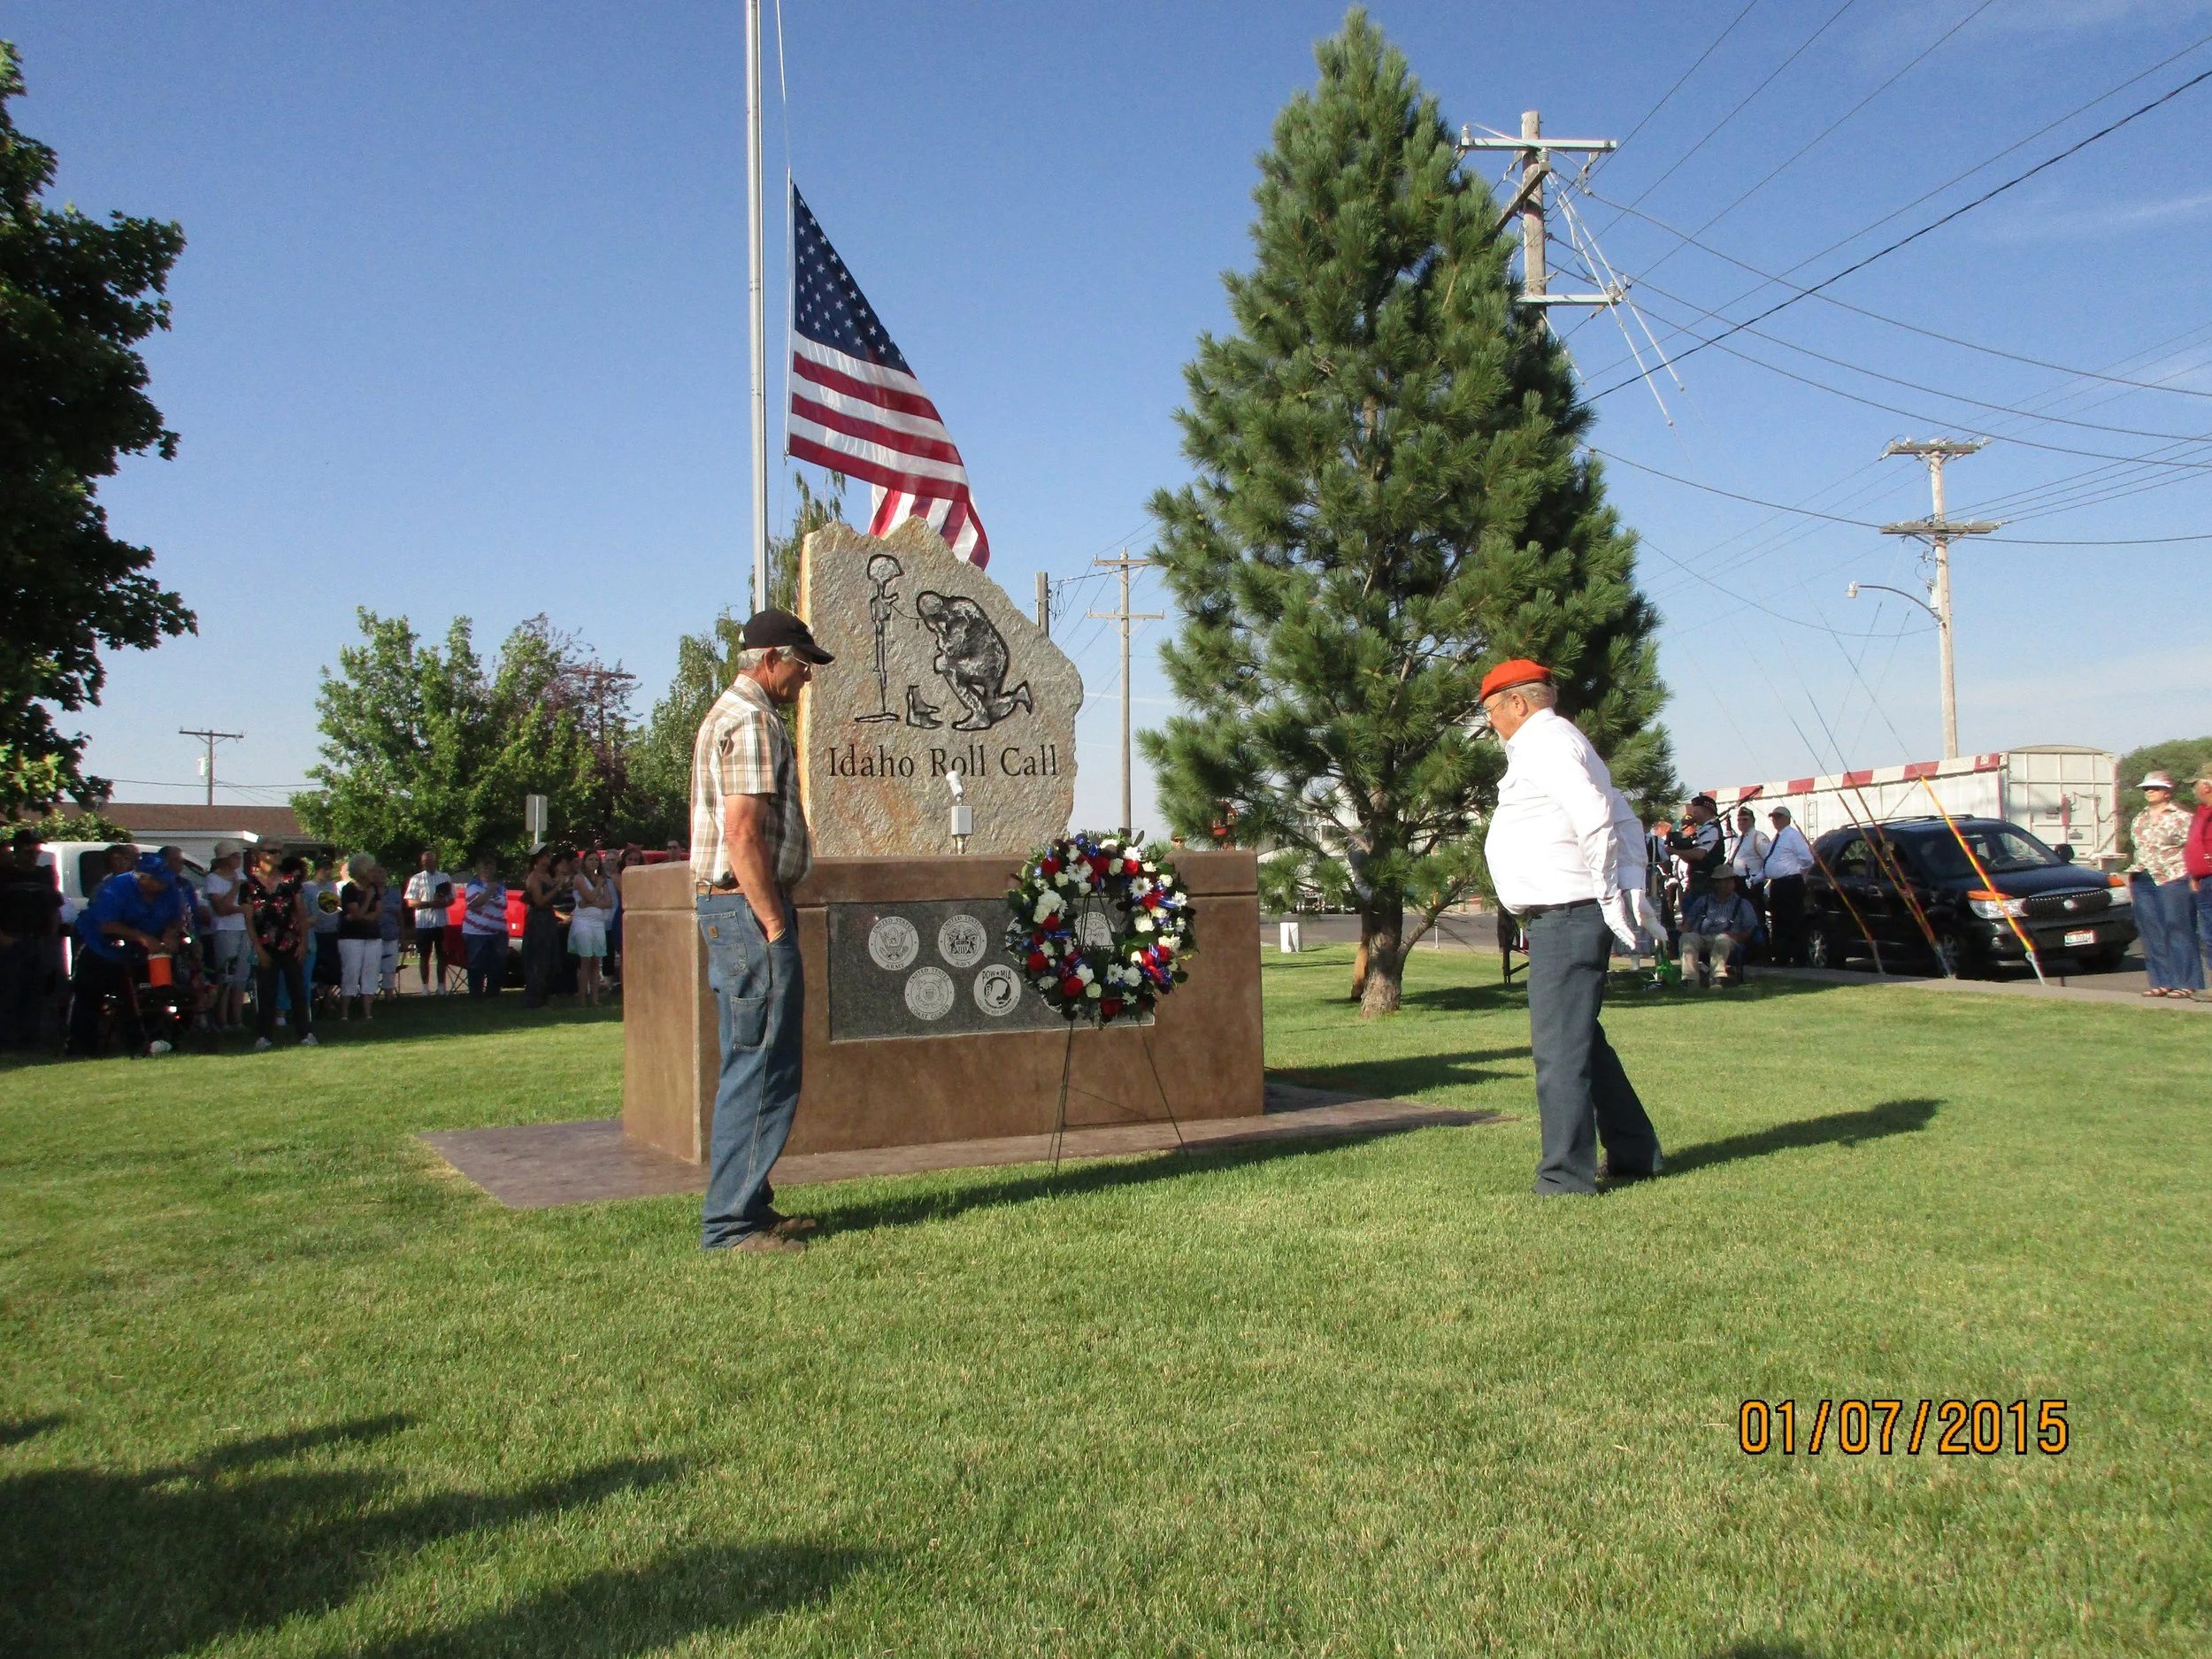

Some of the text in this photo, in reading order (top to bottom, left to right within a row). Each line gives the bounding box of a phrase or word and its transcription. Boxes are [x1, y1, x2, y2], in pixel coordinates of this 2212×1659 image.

[829, 743, 1059, 778] Idaho Roll Call
[872, 918, 893, 933] UNITED
[909, 968, 929, 984] UNITED
[911, 1006, 928, 1018] COAST
